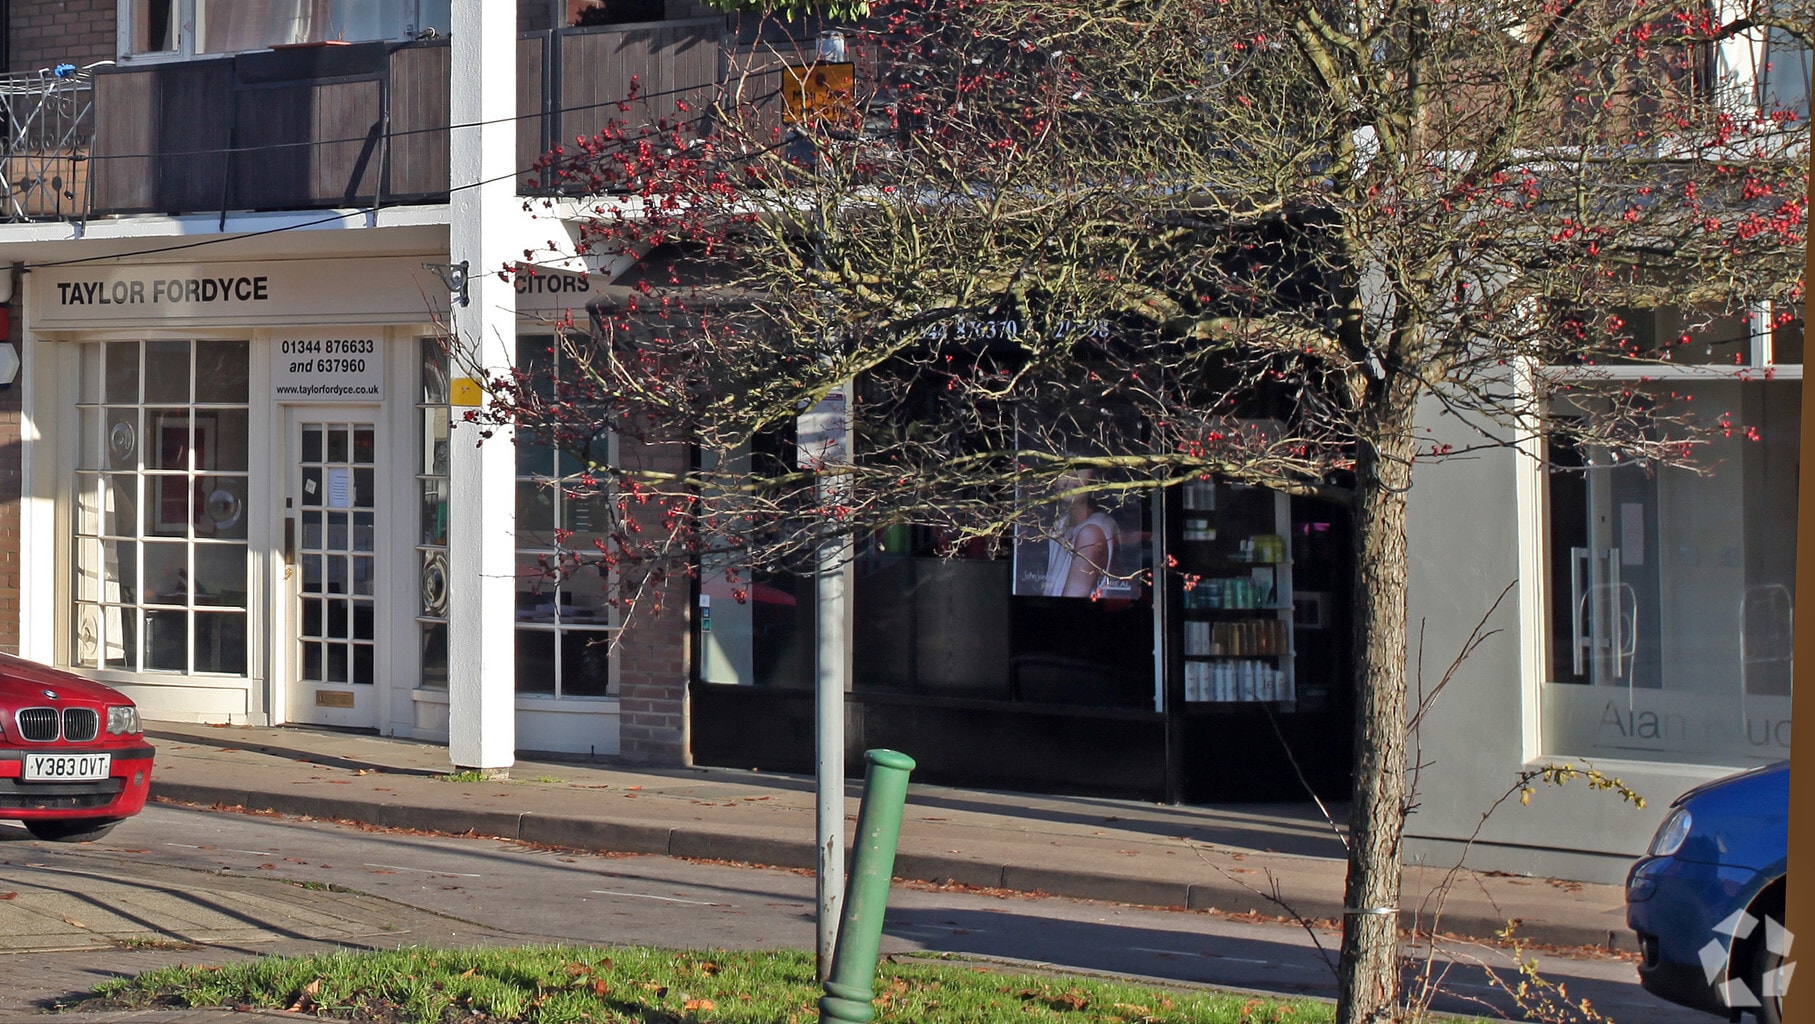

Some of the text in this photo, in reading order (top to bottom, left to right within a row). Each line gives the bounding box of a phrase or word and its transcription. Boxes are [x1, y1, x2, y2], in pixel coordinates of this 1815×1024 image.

[57, 276, 268, 305] TAYLOR FORDYCE
[281, 339, 374, 354] 01344 876633
[289, 358, 365, 373] and 637960
[276, 384, 379, 396] www.taylorfordyce.co.uk
[35, 757, 105, 776] Y383 OVT
